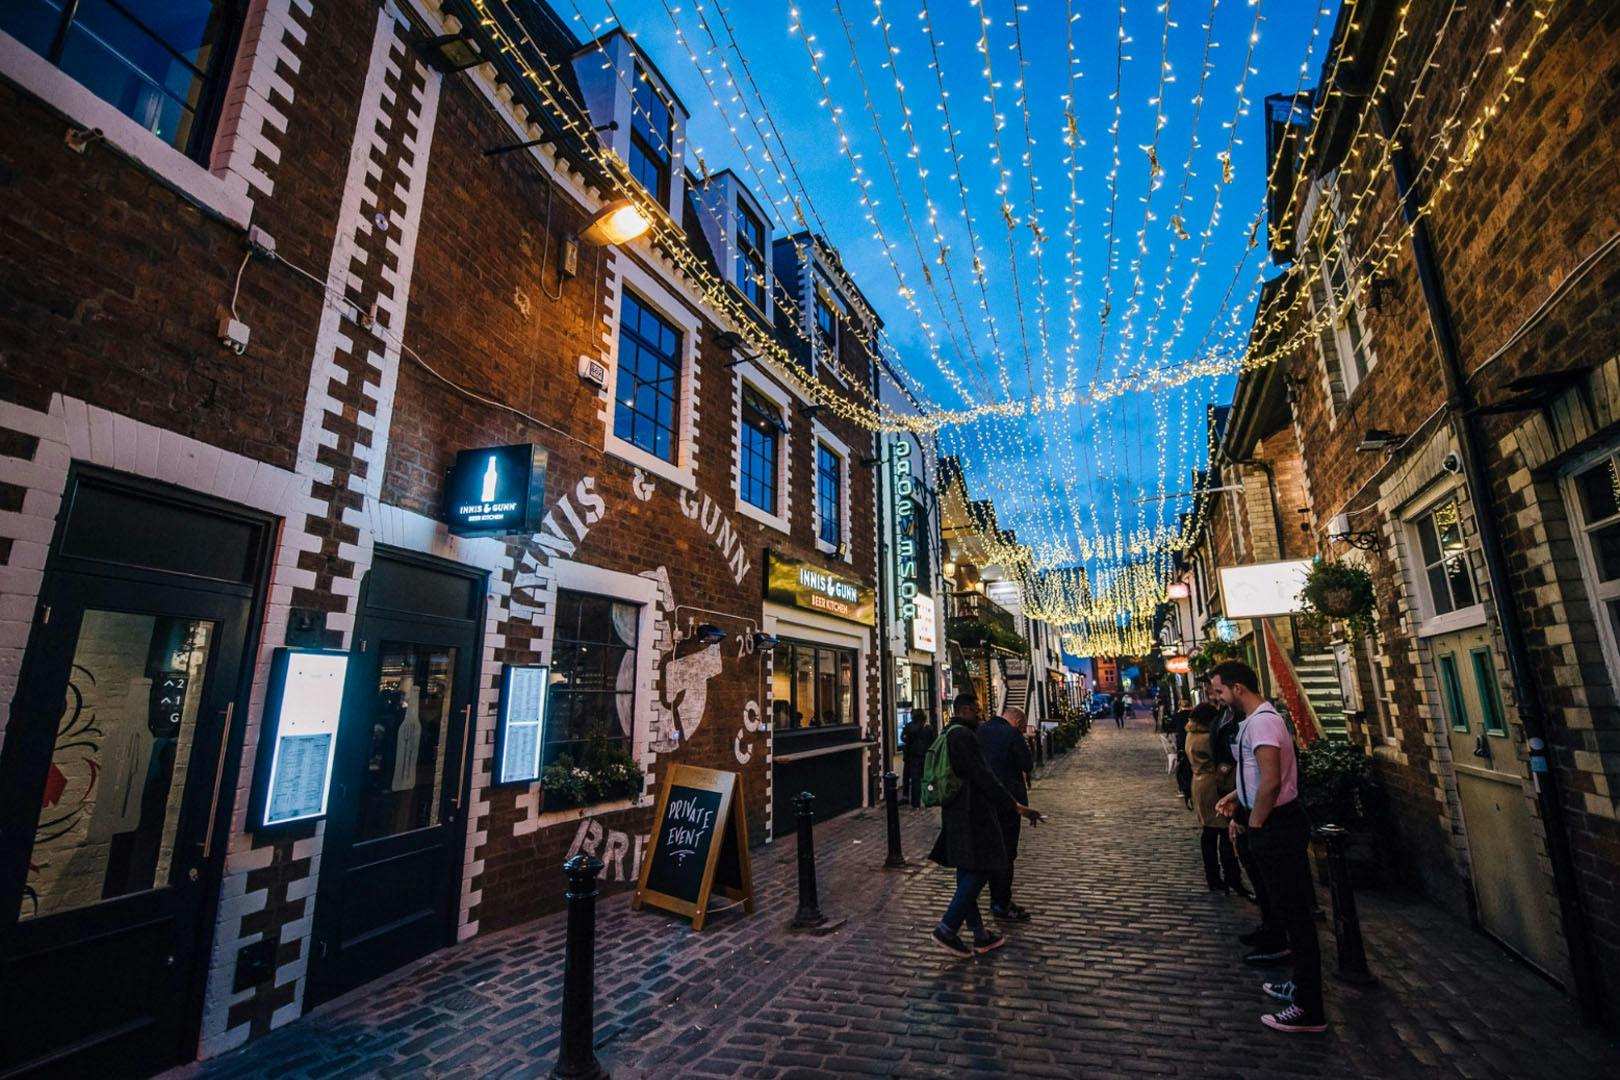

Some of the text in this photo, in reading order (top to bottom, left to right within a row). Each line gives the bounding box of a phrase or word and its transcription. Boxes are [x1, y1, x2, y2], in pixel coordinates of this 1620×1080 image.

[460, 503, 517, 514] INNIS & GUNN
[679, 488, 751, 586] GUNN
[800, 568, 857, 603] INNIS & GUNN
[811, 594, 848, 615] BEER KITCHEN
[177, 679, 185, 689] 2
[175, 696, 181, 705] 1
[169, 712, 180, 723] G
[668, 797, 713, 829] PRIVATE
[667, 826, 705, 849] EVENT
